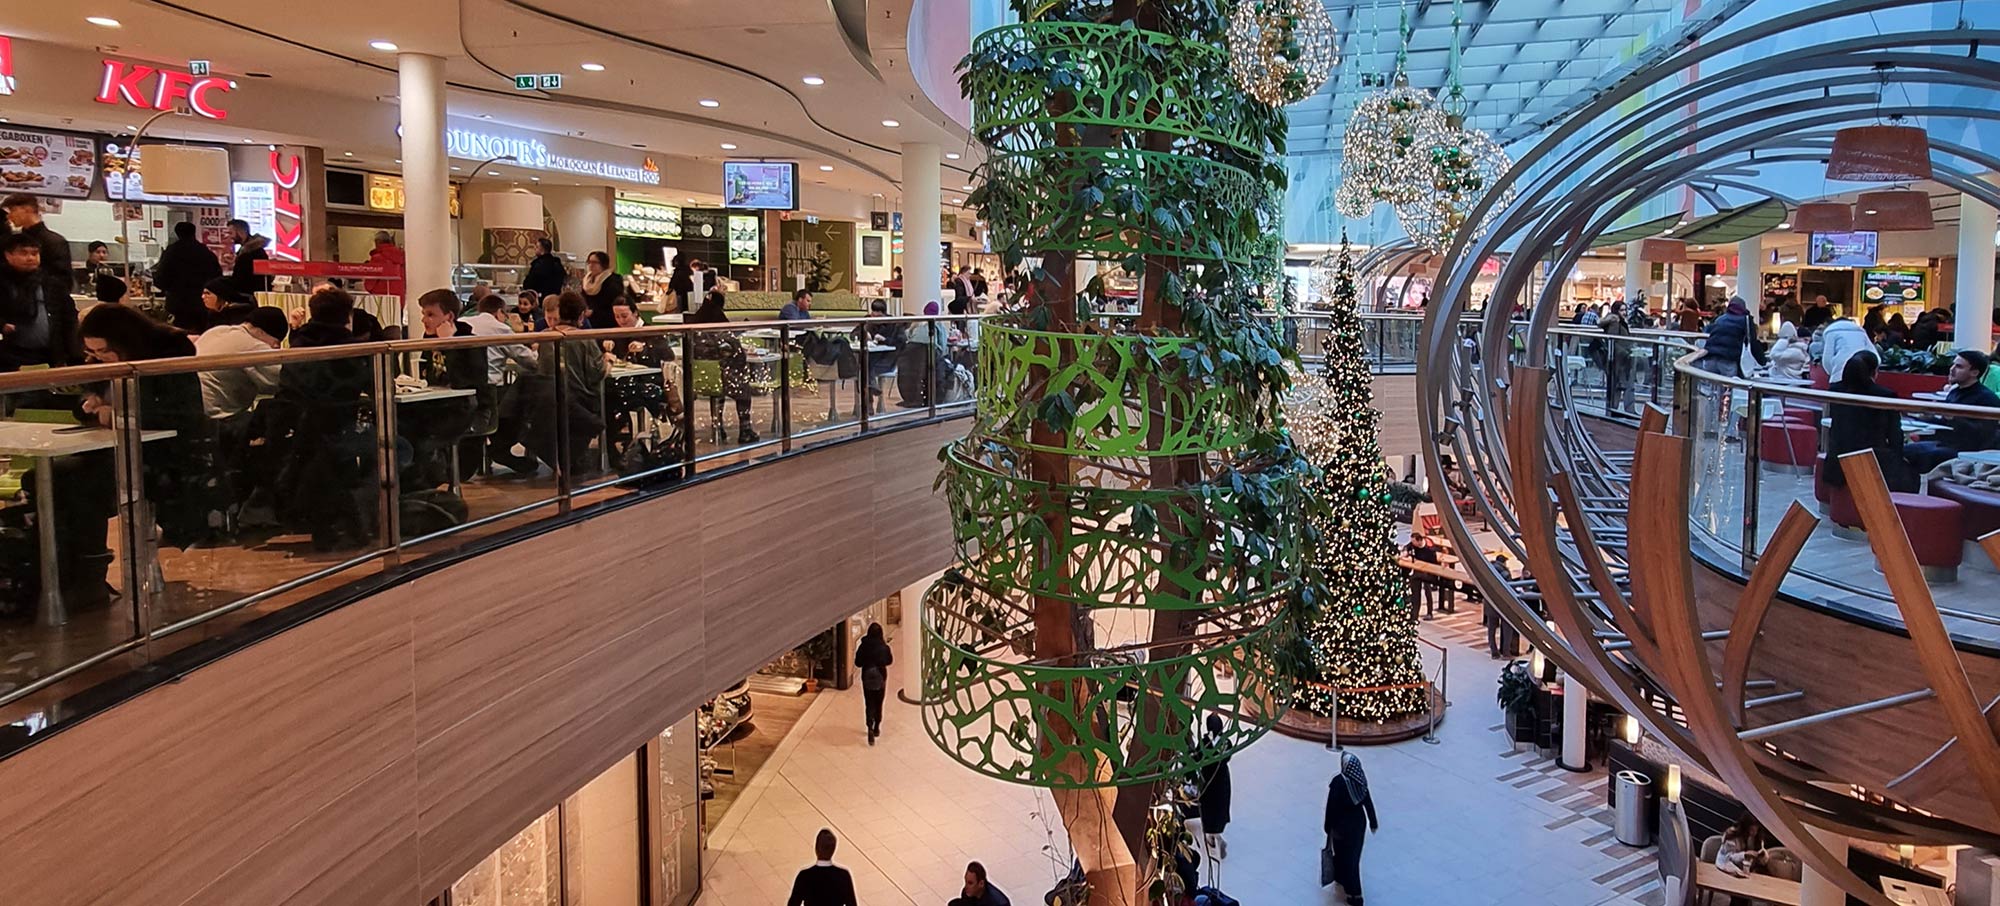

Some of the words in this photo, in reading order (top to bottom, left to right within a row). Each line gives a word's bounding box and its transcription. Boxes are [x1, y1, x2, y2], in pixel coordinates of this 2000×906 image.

[95, 59, 230, 120] KFC
[0, 131, 43, 144] GABOXEN
[446, 129, 546, 166] OUNOUR'S
[269, 151, 303, 262] KFC
